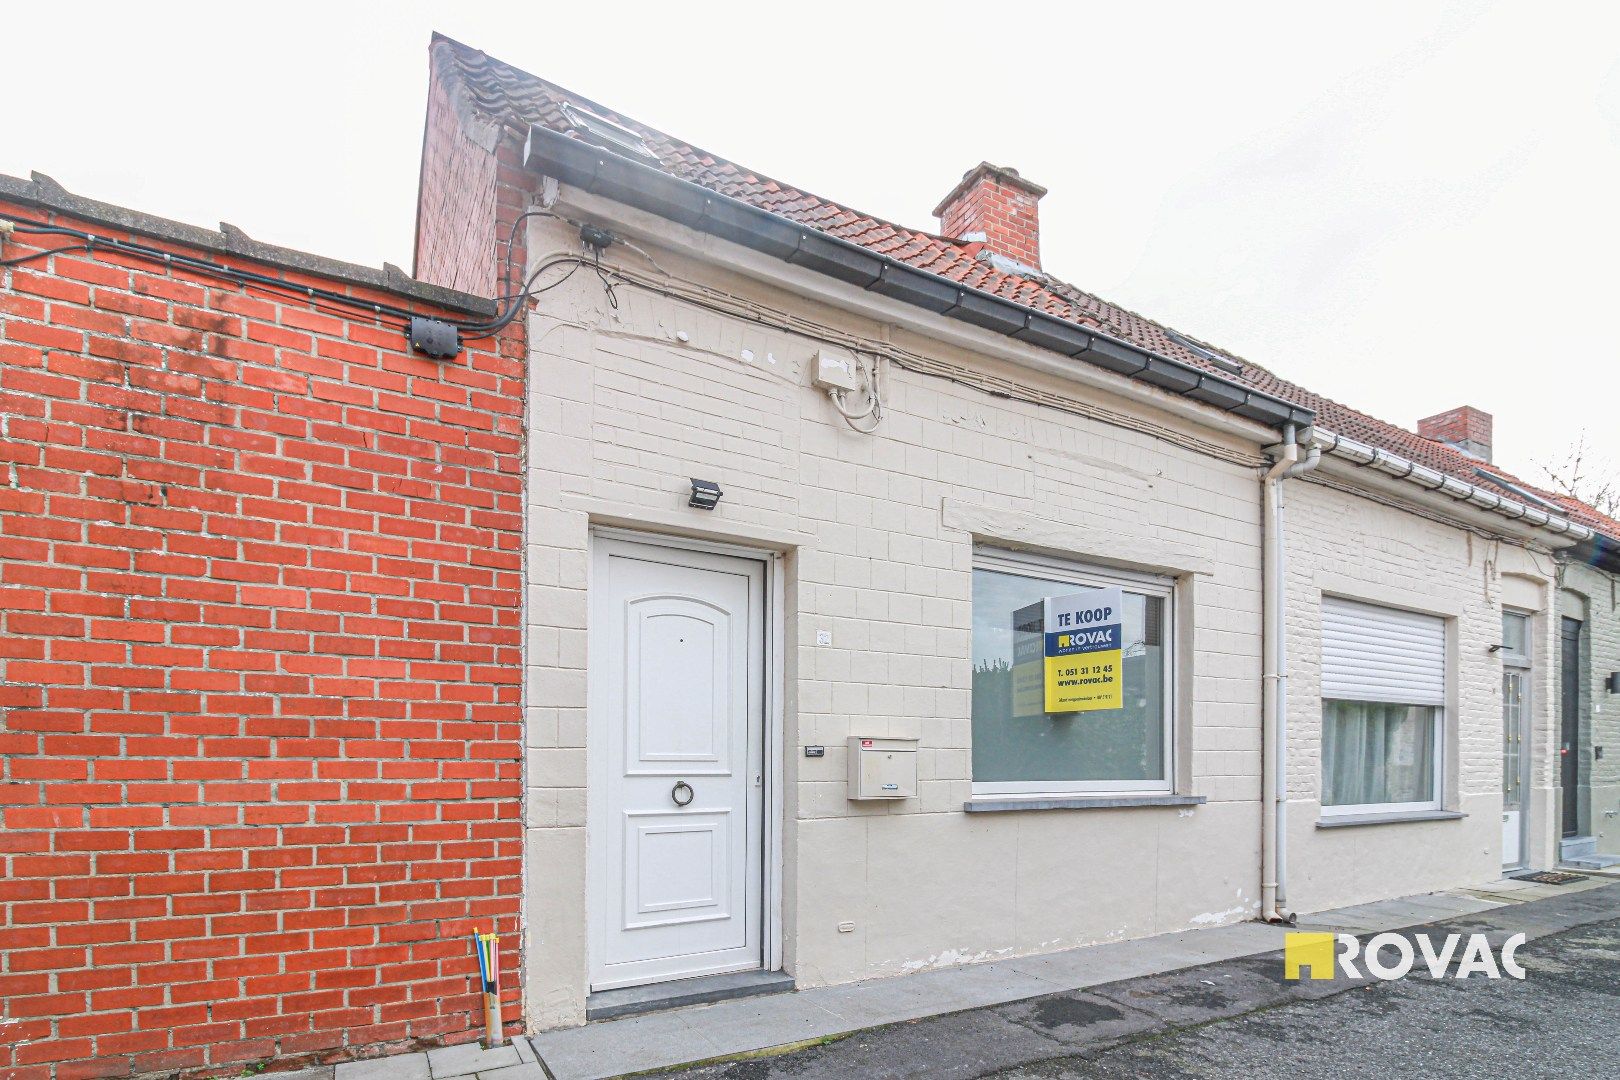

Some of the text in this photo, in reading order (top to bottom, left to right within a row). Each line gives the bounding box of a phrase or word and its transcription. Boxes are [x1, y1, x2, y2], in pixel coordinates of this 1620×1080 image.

[1058, 607, 1112, 626] TE KOOP
[1069, 630, 1112, 646] ROVAC
[1058, 665, 1112, 677] T. 051 31 12 45
[1058, 674, 1113, 686] www.rovac.be
